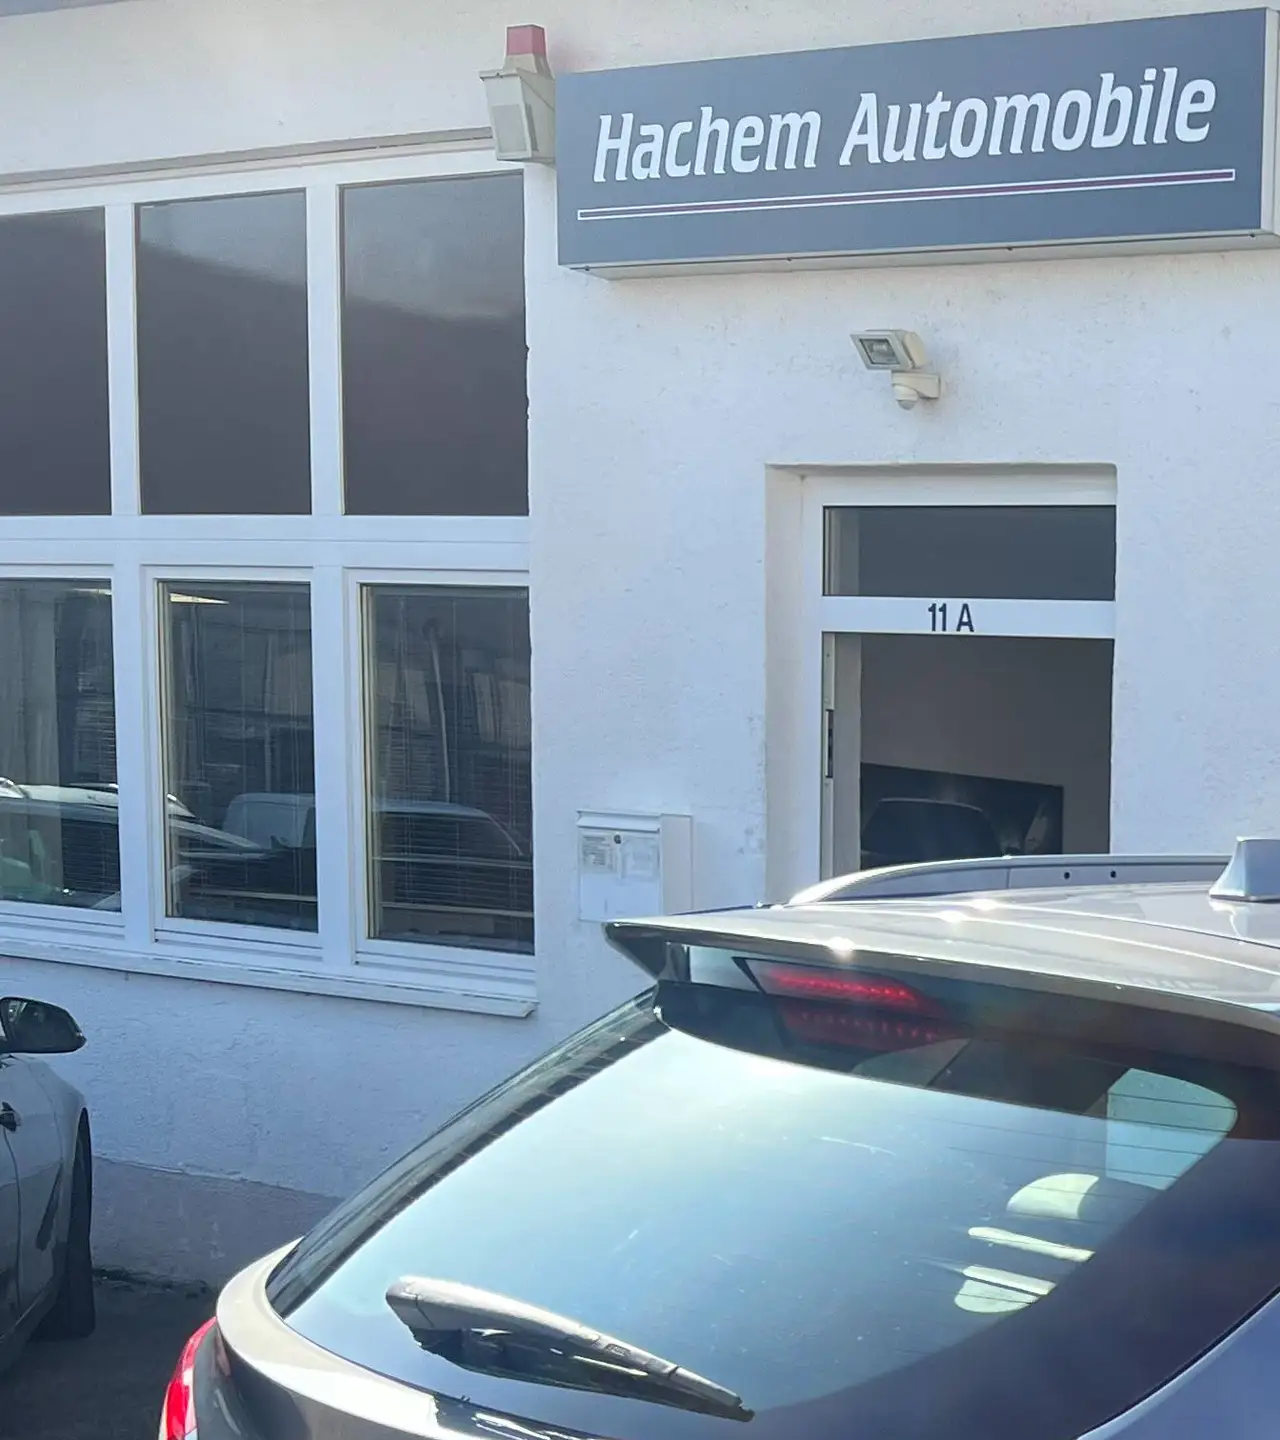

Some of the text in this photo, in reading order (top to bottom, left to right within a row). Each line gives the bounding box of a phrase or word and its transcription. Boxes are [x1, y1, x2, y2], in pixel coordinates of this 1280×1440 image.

[592, 66, 1218, 184] Hachem Automobile
[927, 602, 975, 633] 11 A
